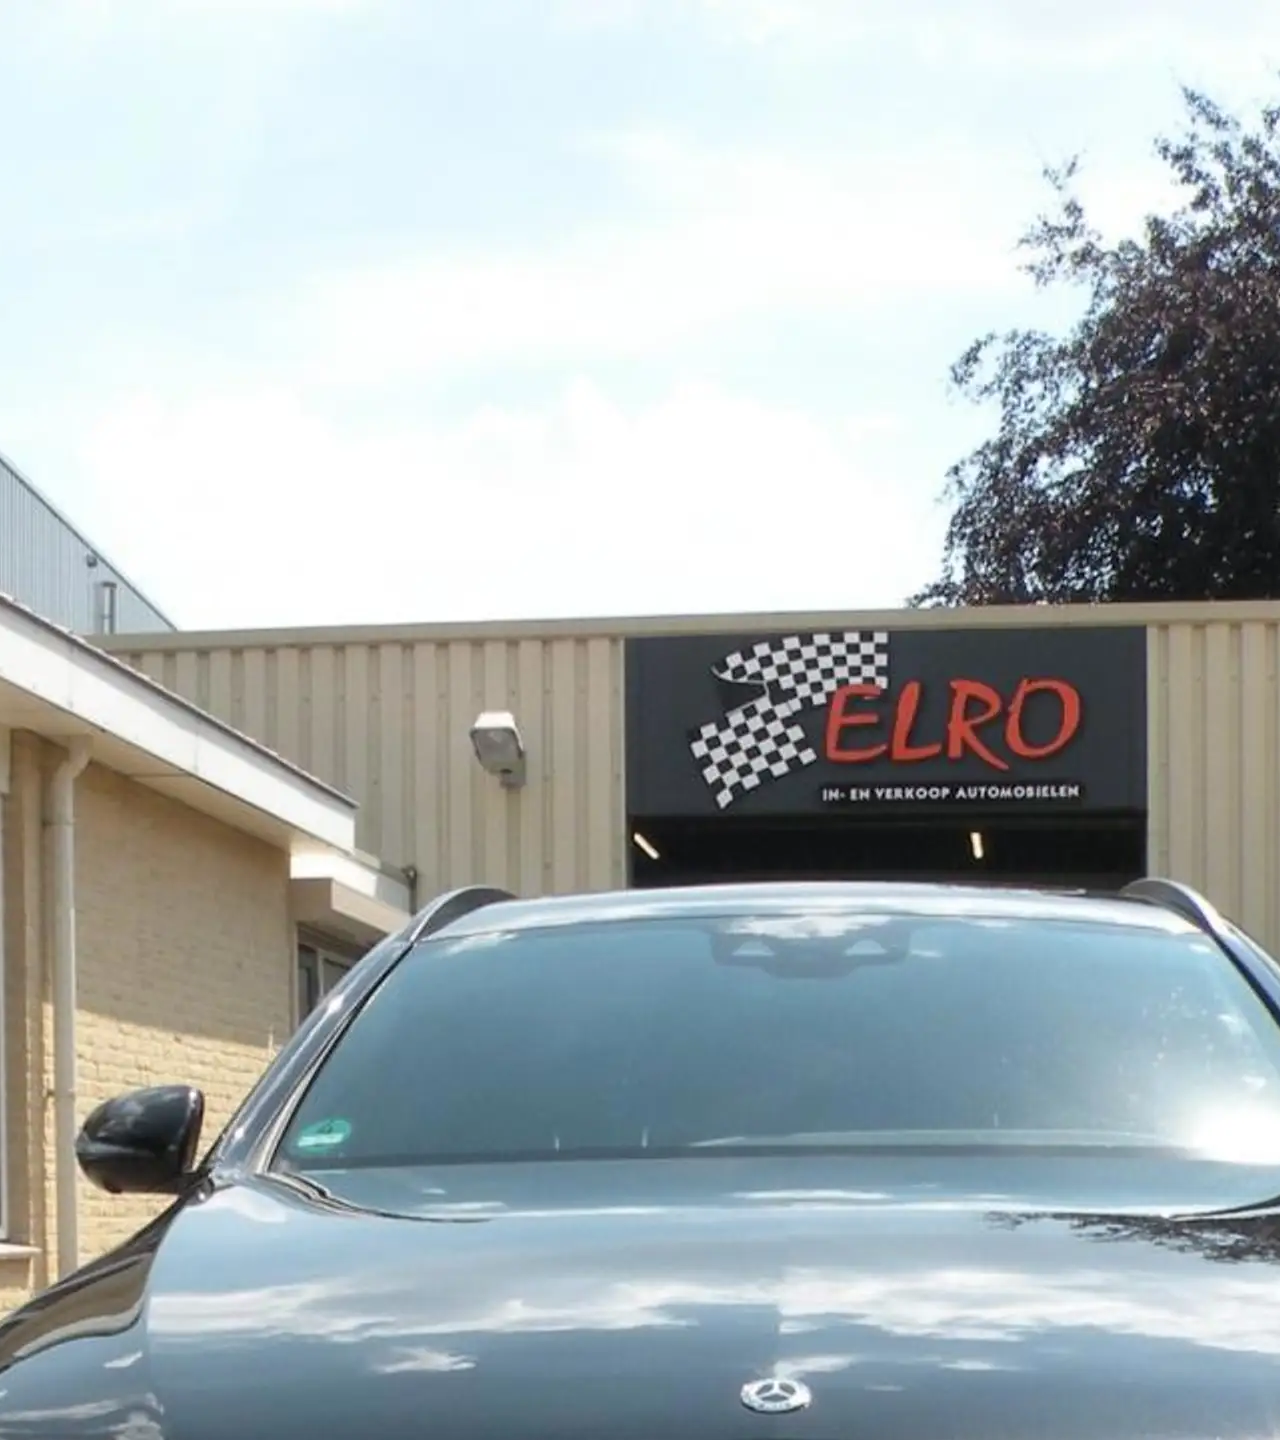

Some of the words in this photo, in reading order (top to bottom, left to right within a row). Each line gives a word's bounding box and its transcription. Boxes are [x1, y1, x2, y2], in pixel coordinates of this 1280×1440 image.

[824, 679, 1082, 770] ELRO
[822, 788, 846, 801] IN-
[850, 787, 869, 800] EN
[874, 786, 950, 800] VERKOOP
[955, 784, 1079, 799] AUTOMOBIELEN
